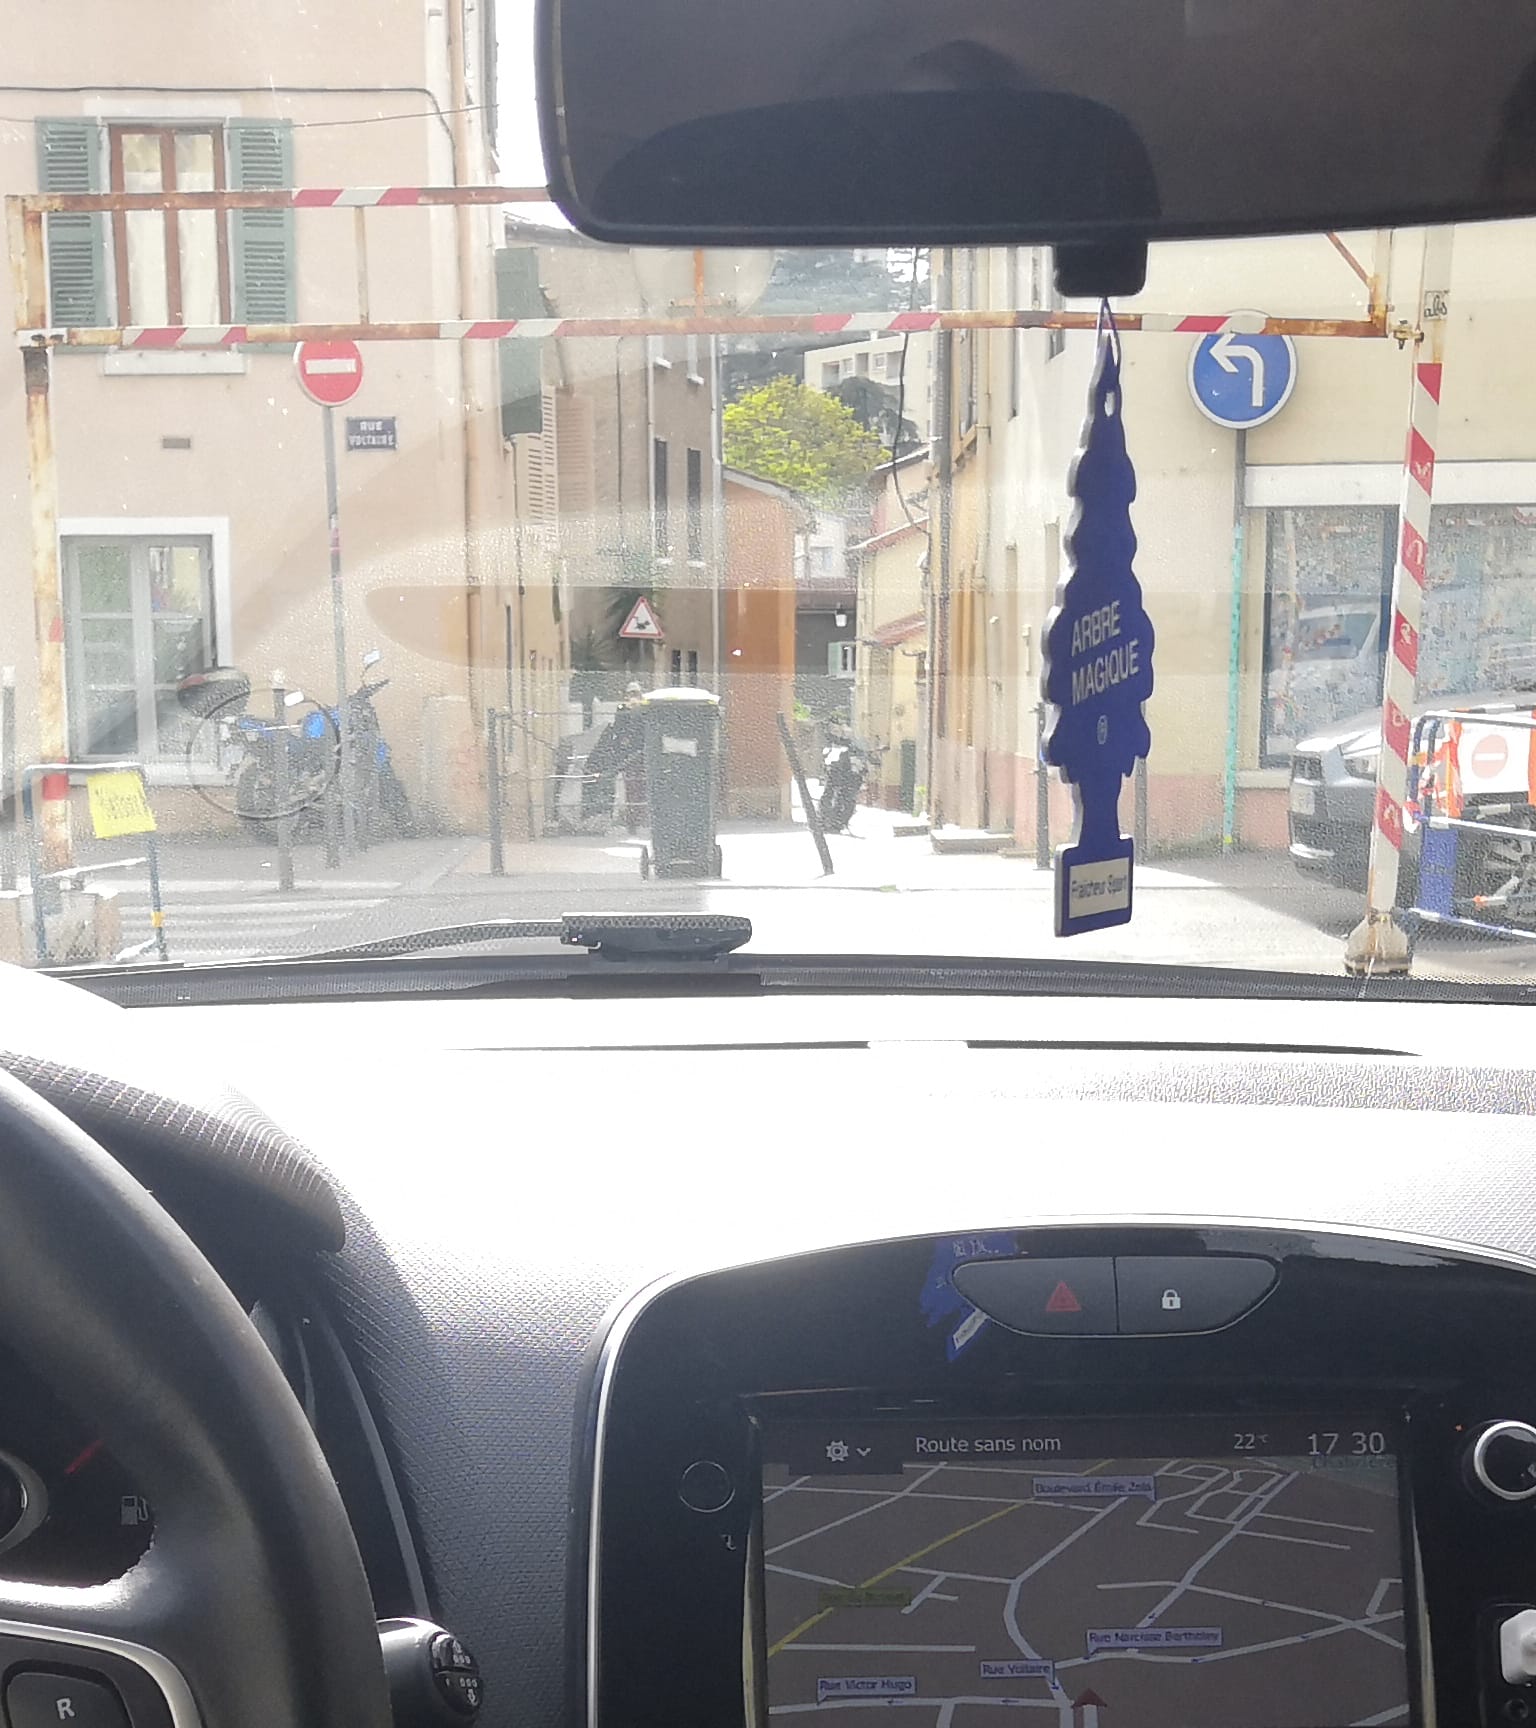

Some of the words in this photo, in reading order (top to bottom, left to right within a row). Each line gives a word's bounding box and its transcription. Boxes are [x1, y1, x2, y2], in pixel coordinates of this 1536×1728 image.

[1070, 599, 1121, 658] ARBRE
[1071, 637, 1140, 707] MAGIQUE
[915, 1436, 969, 1453] Route
[974, 1439, 1016, 1452] sans
[1021, 1437, 1063, 1452] nom
[56, 1697, 76, 1720] R
